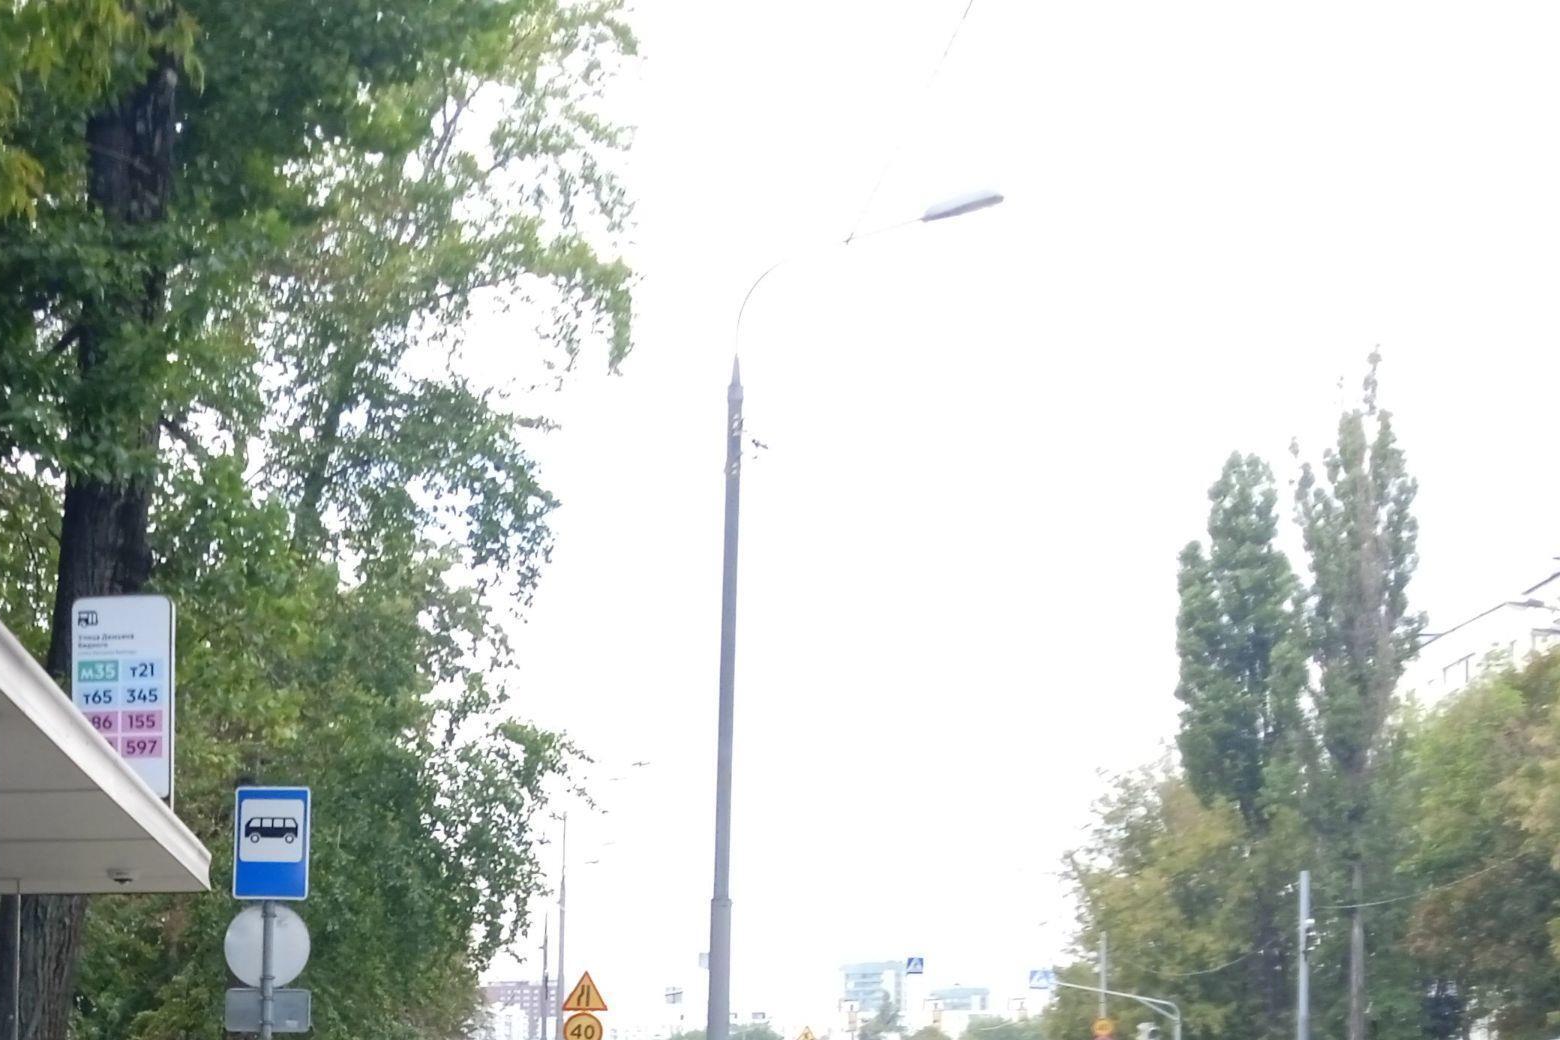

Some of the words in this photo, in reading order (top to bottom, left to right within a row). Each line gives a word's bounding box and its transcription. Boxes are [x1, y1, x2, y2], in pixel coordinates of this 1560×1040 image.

[126, 688, 158, 703] 345
[128, 715, 155, 729] 155
[126, 740, 157, 754] 597
[569, 1024, 595, 1040] 40
